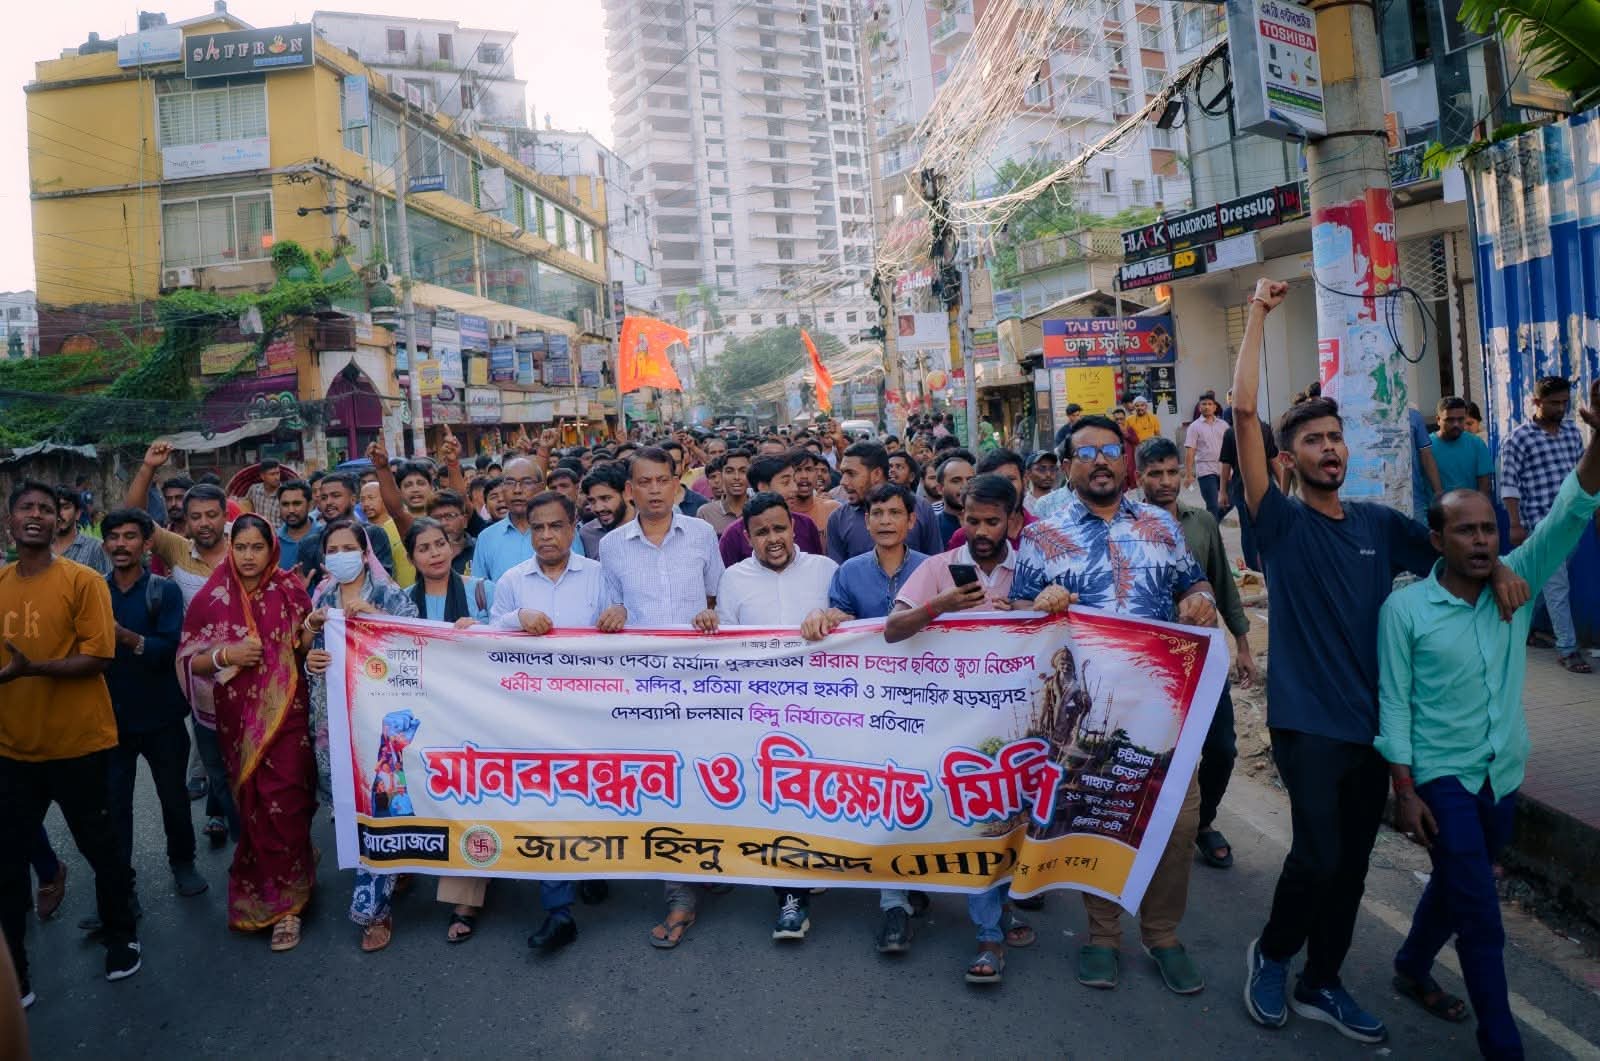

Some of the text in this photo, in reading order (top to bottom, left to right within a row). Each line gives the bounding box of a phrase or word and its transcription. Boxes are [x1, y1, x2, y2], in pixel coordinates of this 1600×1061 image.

[1263, 23, 1313, 49] TOSHIBA
[1168, 211, 1217, 239] WEARDROBE
[1220, 197, 1275, 225] DressUp
[1065, 321, 1088, 333] TAJ
[386, 648, 419, 661] জাগো
[488, 651, 553, 665] আমাদের
[620, 654, 667, 669] দেবতা
[673, 654, 719, 671] মর্যাদা
[809, 650, 858, 669] শ্রীরাম
[865, 655, 908, 674] চন্দ্রের
[911, 651, 949, 675] ছবিতে
[954, 658, 981, 679] জুতা
[984, 652, 1035, 675] নিক্ষেপ
[387, 675, 419, 688] পরিষদ
[500, 672, 1028, 710] ধর্মীয় অবমাননা, মন্দির, প্রতিমা ধ্বংসের হুমকী ও সাম্প্রদায়িক ষড়যন্ত্রসহ
[611, 702, 925, 734] দেশব্যাপী চলমান হিন্দু নির্যাতনের প্রতিবাদে
[422, 743, 682, 814] মানববন্ধন
[695, 753, 745, 810] ও
[754, 732, 932, 830] বিক্ষোভ
[363, 831, 446, 853] আয়োজনে
[513, 835, 628, 862] জাগো
[640, 826, 724, 873] হিন্দু
[737, 835, 873, 874] পরিষদ
[891, 846, 1017, 878] (JHP)
